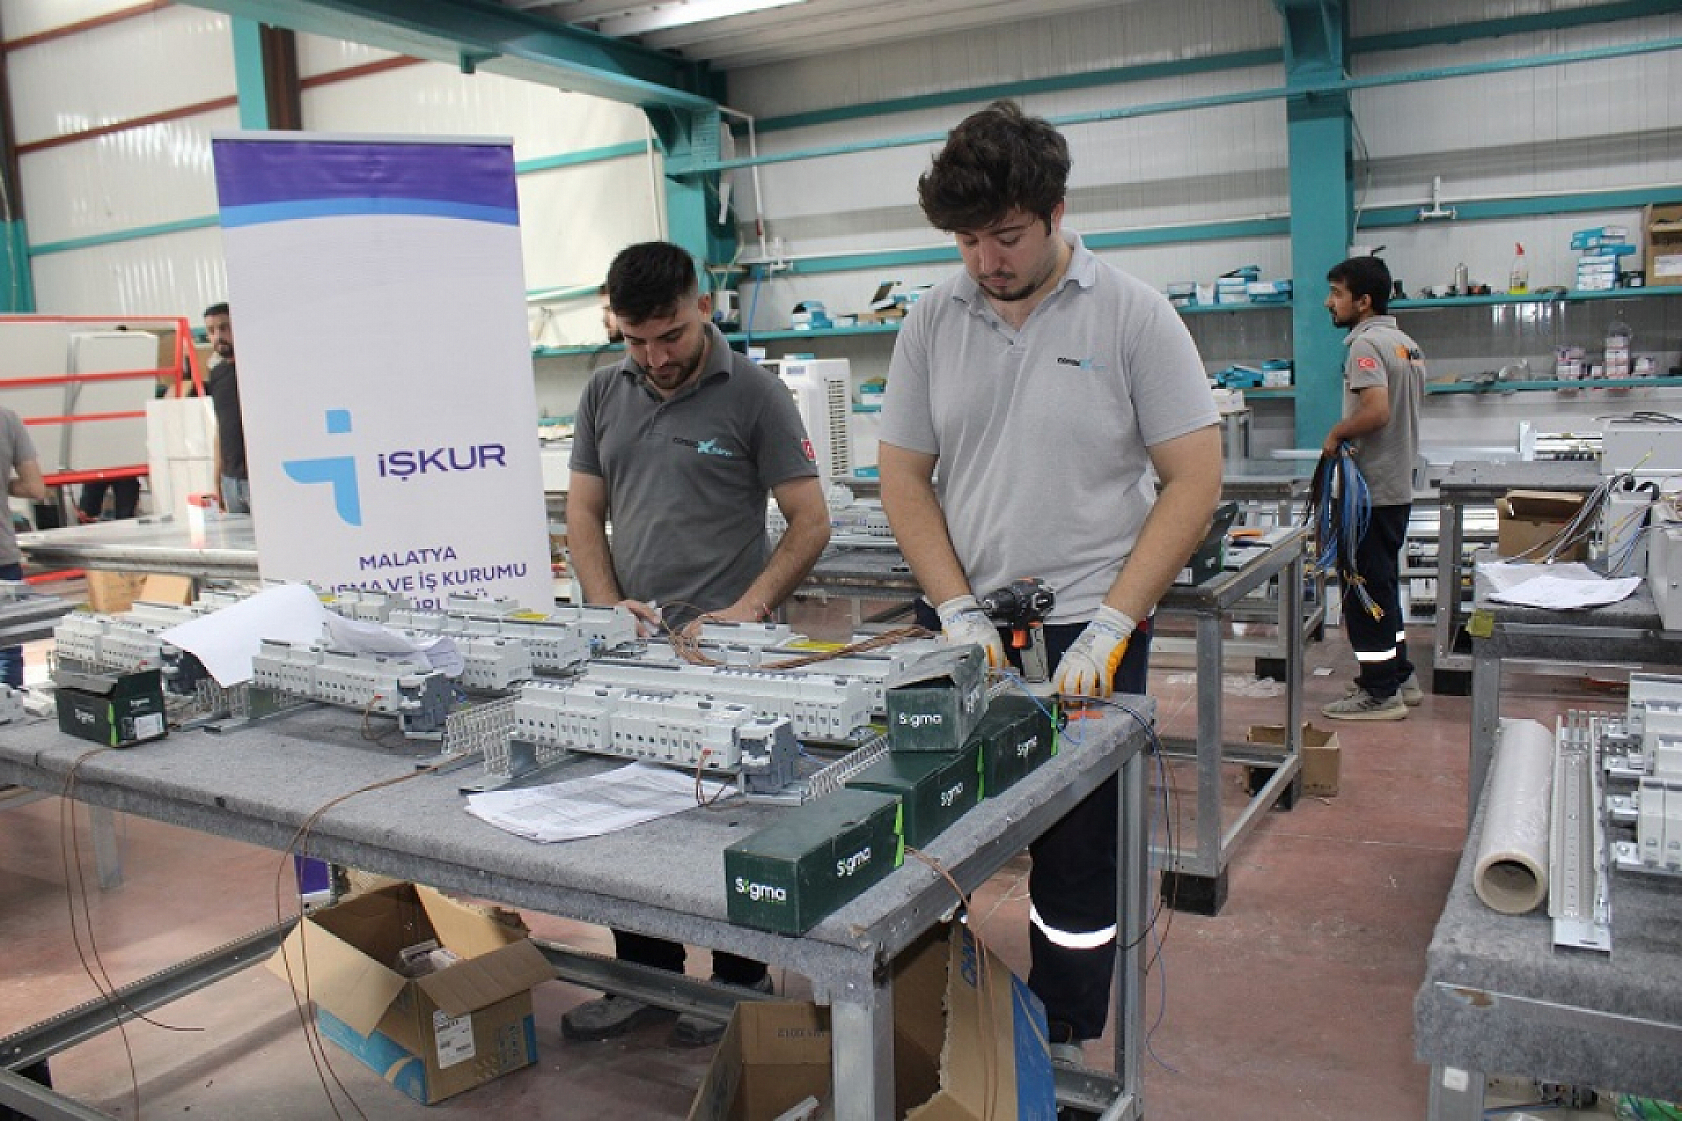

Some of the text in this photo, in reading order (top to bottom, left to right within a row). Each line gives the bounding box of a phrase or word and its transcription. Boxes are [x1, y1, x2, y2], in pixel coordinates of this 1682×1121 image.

[359, 546, 457, 570] MALATYA
[387, 576, 415, 592] VE
[419, 570, 438, 593] İŞ
[442, 563, 527, 586] KURUMU
[734, 876, 787, 903] Sigma
